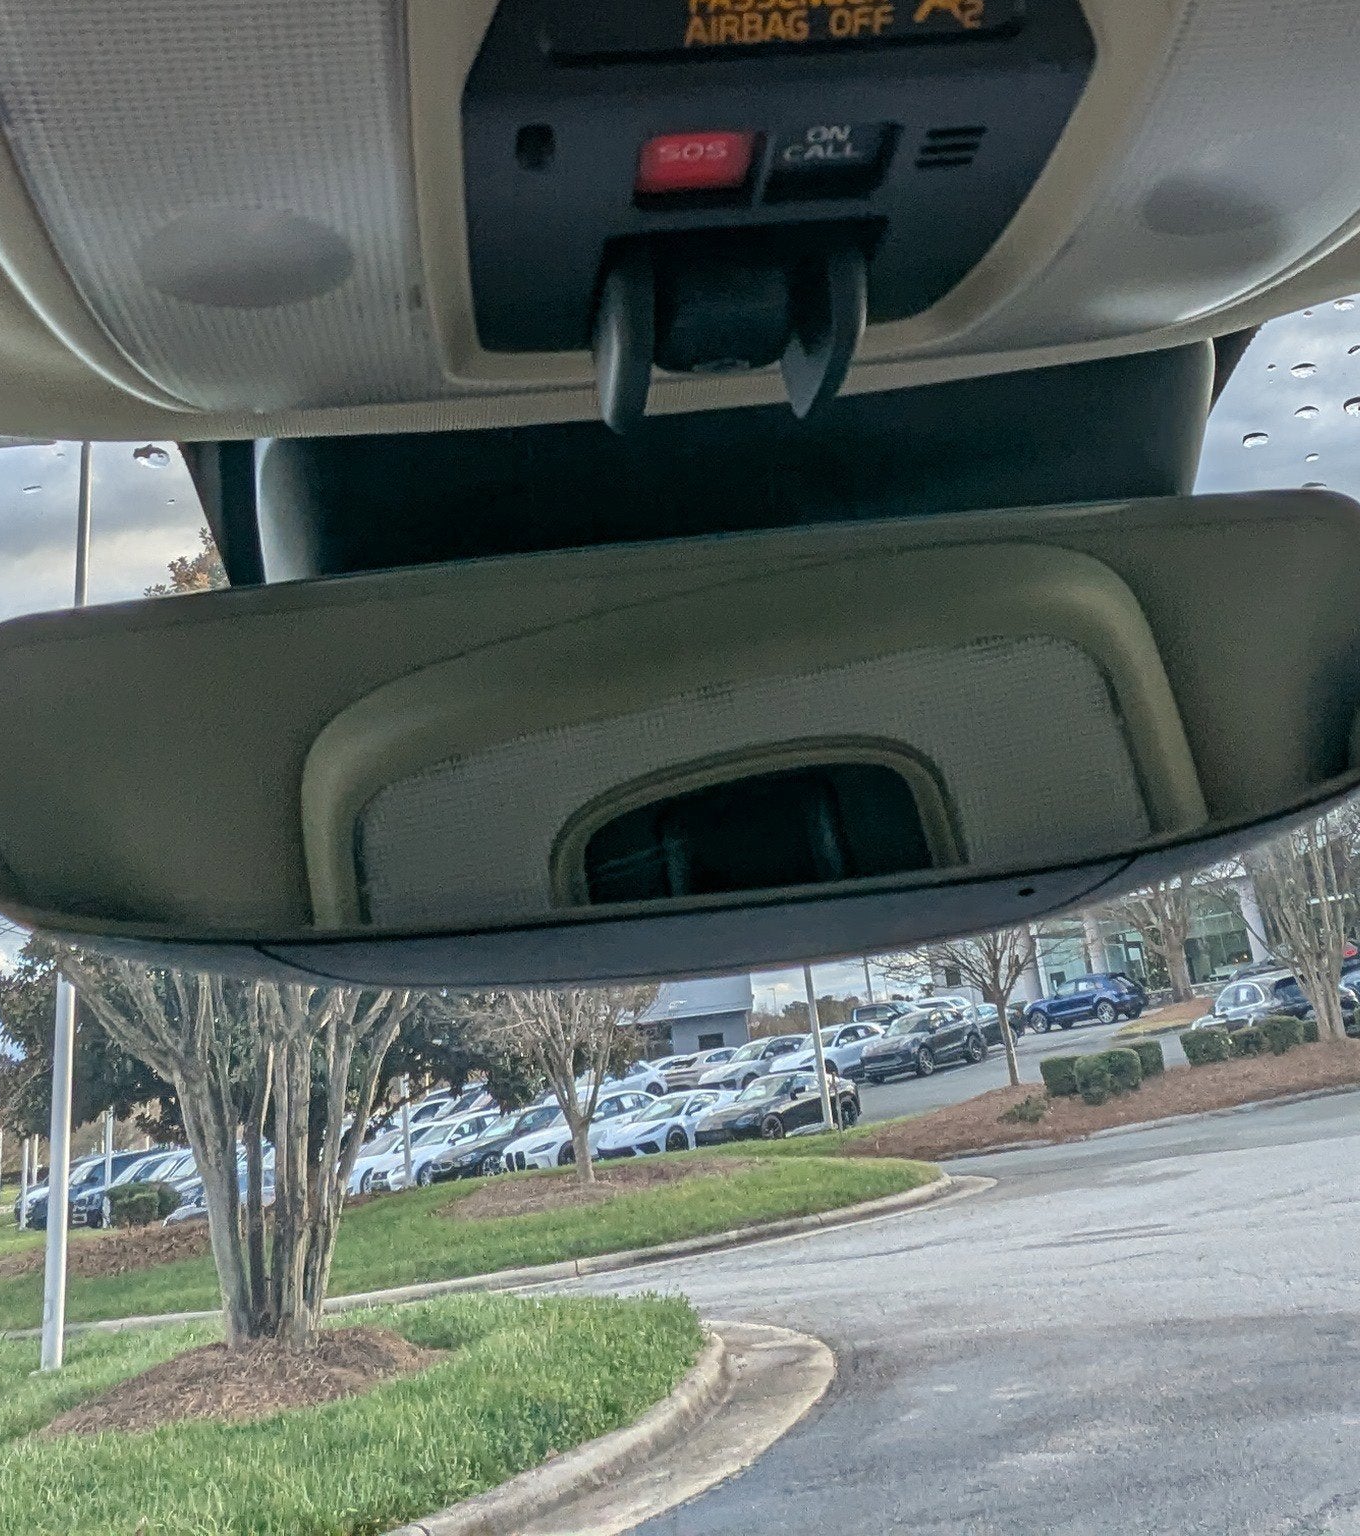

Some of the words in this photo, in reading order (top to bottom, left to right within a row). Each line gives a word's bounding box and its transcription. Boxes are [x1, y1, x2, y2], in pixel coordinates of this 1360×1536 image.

[685, 10, 810, 46] AIRBAG
[830, 5, 894, 38] OFF
[807, 124, 852, 143] ON
[658, 140, 727, 162] SOS
[783, 143, 861, 162] CALL
